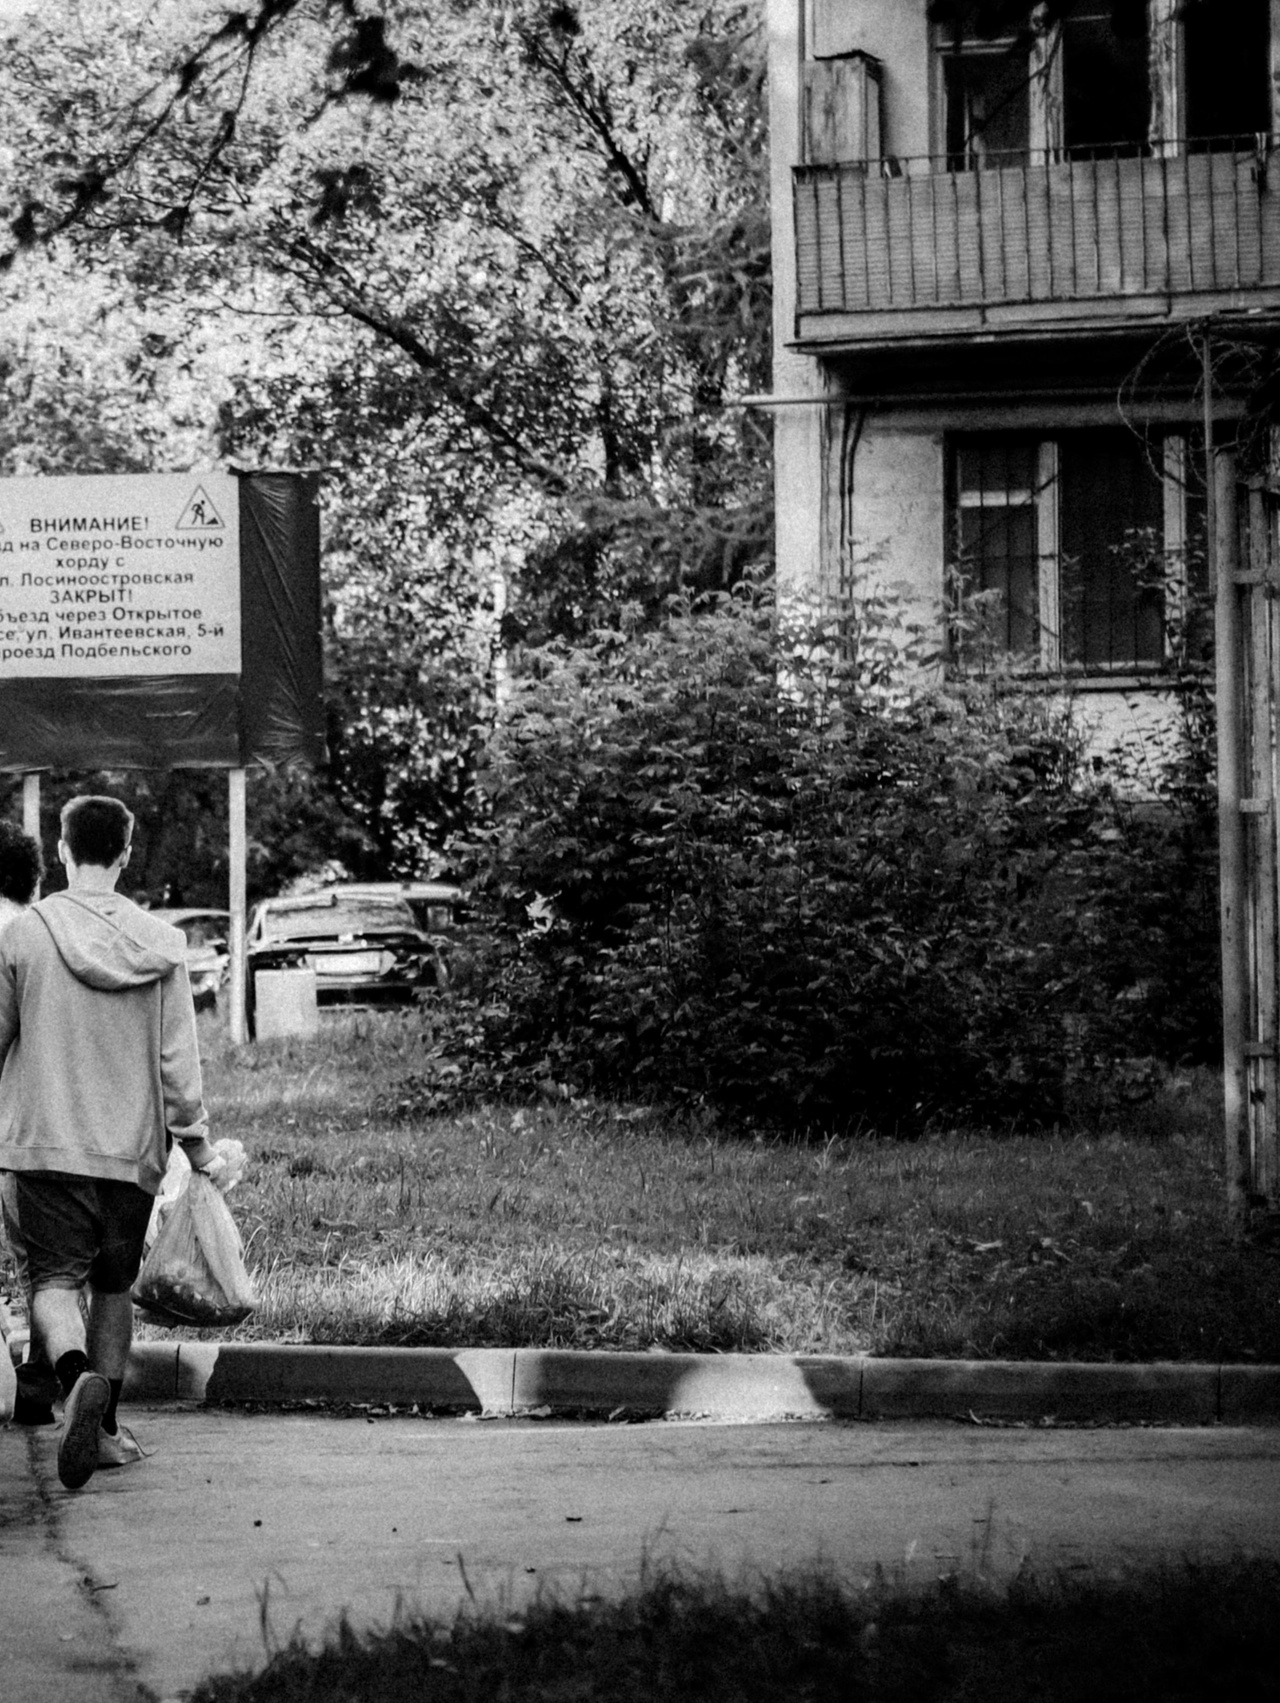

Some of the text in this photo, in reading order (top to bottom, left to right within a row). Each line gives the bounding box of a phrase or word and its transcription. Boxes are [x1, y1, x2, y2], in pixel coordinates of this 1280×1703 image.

[30, 517, 149, 533] ВНИМАНИЕ!
[20, 541, 40, 551] на
[46, 535, 223, 552] Северо-Восточную
[56, 557, 125, 570] хорду с
[21, 572, 193, 588] Лосиноостровская
[50, 589, 132, 604] ЗАКРЫТ!
[55, 610, 106, 624] через
[112, 606, 202, 623] Открытое
[27, 629, 53, 643] ул.
[59, 625, 191, 640] Ивантеевская,
[197, 622, 224, 637] 5-й
[61, 642, 192, 659] Подбельского
